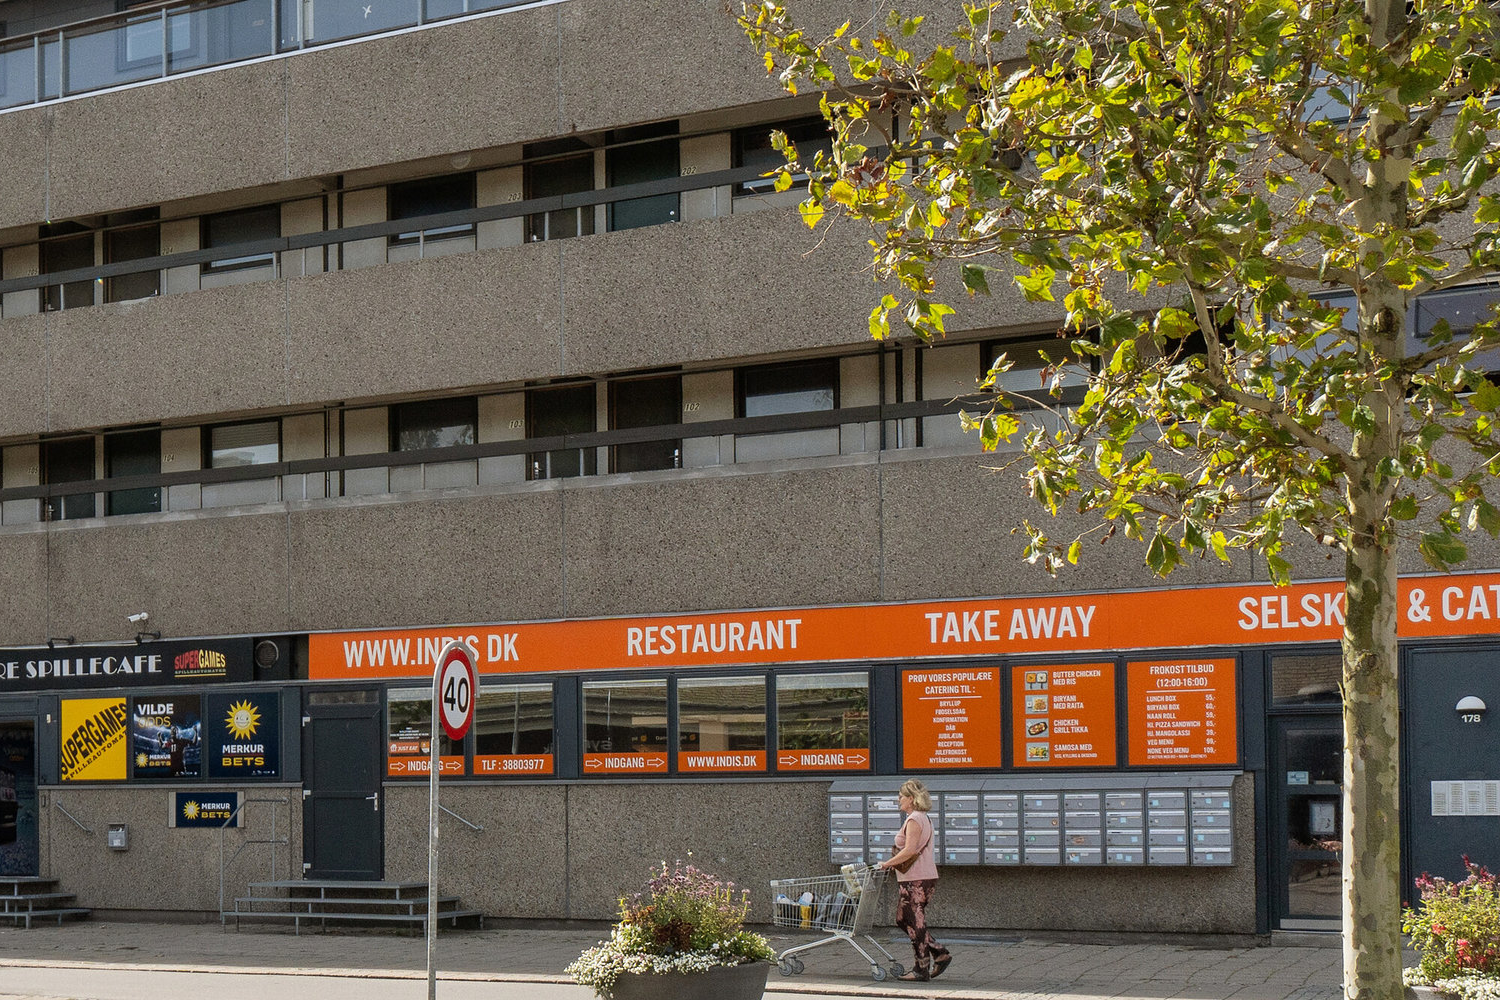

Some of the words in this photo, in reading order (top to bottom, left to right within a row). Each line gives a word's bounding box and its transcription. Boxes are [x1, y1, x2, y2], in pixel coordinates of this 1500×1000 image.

[682, 166, 696, 176] 202
[508, 192, 522, 201] 203
[684, 402, 700, 412] 102
[509, 419, 523, 429] 103
[1238, 592, 1345, 630] SELSK
[1407, 588, 1432, 623] &
[924, 609, 1000, 644] TAKE
[1008, 605, 1096, 641] AWAY
[627, 619, 802, 656] RESTAURANT
[26, 655, 162, 679] SPILLECAFE
[1150, 665, 1185, 675] FROKOST
[1186, 664, 1214, 673] TILBUD
[908, 674, 927, 682] PRØV
[928, 673, 952, 682] VORES
[952, 672, 992, 681] POPULÆRE
[1156, 677, 1208, 688] (12:00-16:00)
[444, 677, 469, 713] 40
[925, 686, 959, 694] CATERING
[960, 685, 971, 693] TIL
[137, 703, 174, 716] VILDE
[138, 716, 171, 728] ODDS
[1461, 714, 1481, 723] 178
[222, 744, 264, 754] MERKUR
[222, 757, 264, 767] BETS
[407, 760, 444, 771] INDGAG
[482, 760, 496, 770] TLF
[502, 759, 544, 770] 38803977
[604, 757, 645, 769] INDGANG
[687, 755, 757, 768] WWW.INDIS.DK
[800, 754, 844, 766] INDGANG
